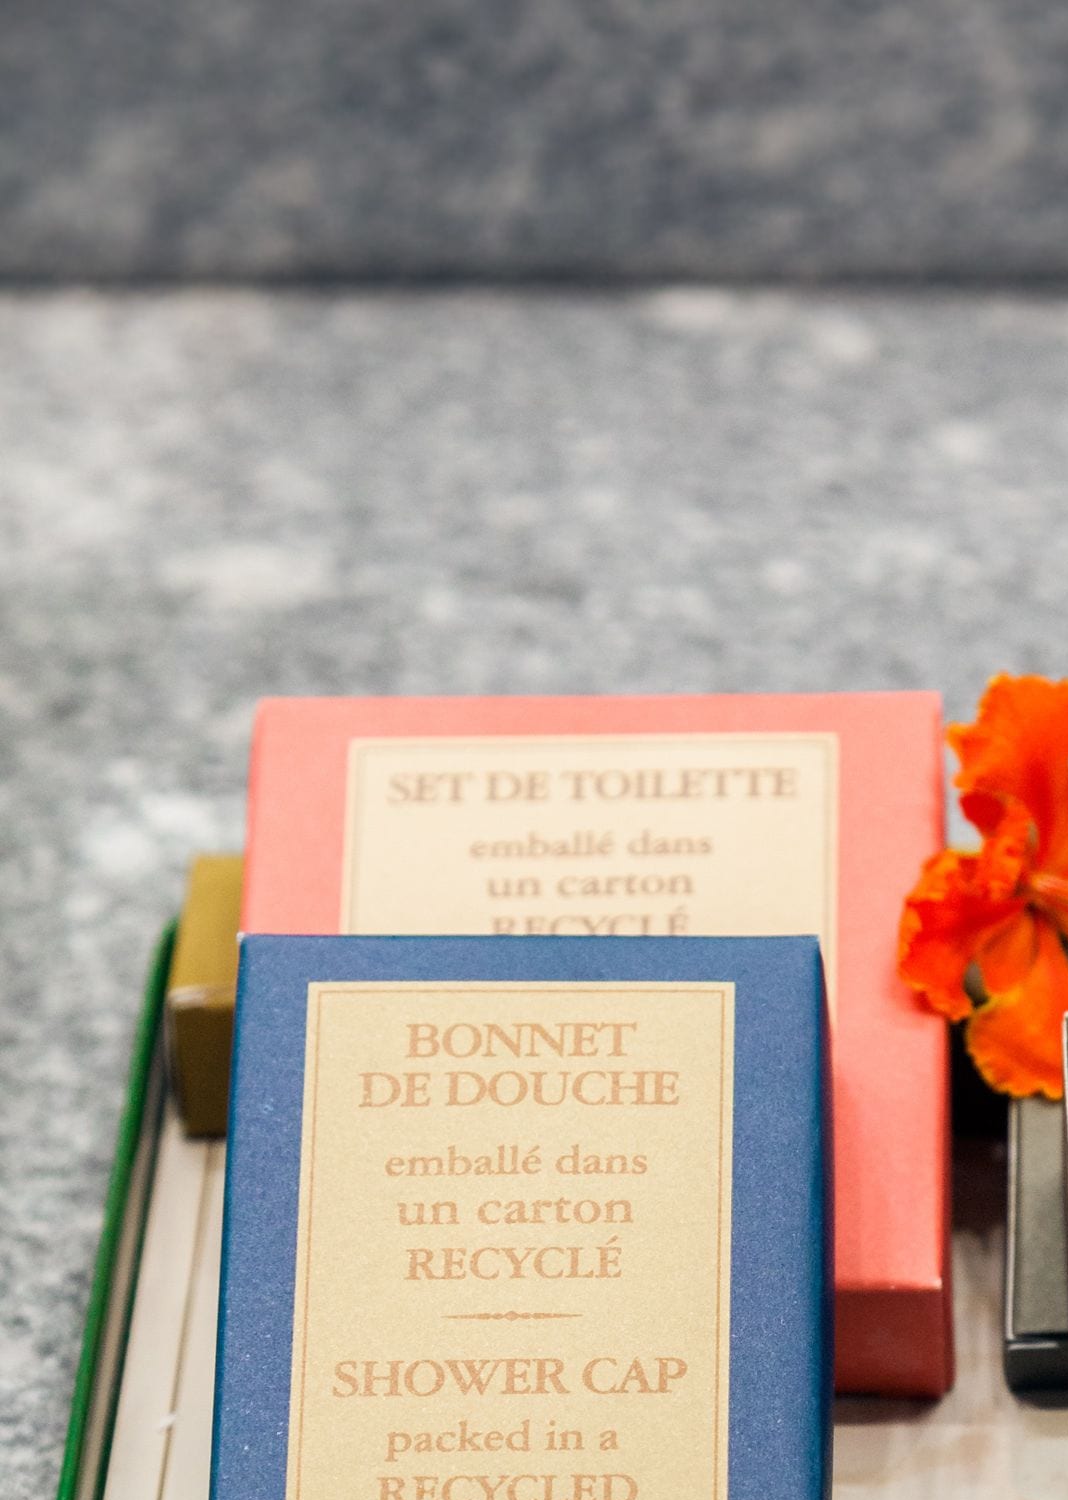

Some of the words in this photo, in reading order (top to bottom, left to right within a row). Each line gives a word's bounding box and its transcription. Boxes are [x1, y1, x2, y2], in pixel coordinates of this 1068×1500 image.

[387, 771, 472, 804] SET
[486, 770, 550, 801] DE
[561, 767, 797, 801] TOILETTE
[468, 831, 615, 860] emballé
[627, 829, 713, 857] dans
[487, 876, 541, 899] un
[557, 873, 694, 898] carton
[406, 1022, 638, 1060] BONNET
[359, 1071, 431, 1109] DE
[445, 1070, 681, 1108] DOUCHE
[384, 1144, 542, 1179] emballé
[555, 1143, 649, 1177] dans
[397, 1199, 461, 1227] un
[478, 1196, 634, 1226] carton
[403, 1236, 624, 1281] RECYCLÉ
[332, 1357, 570, 1399] SHOWER
[582, 1356, 689, 1395] CAP
[386, 1420, 531, 1462] packed
[546, 1421, 583, 1453] in
[600, 1431, 619, 1452] a
